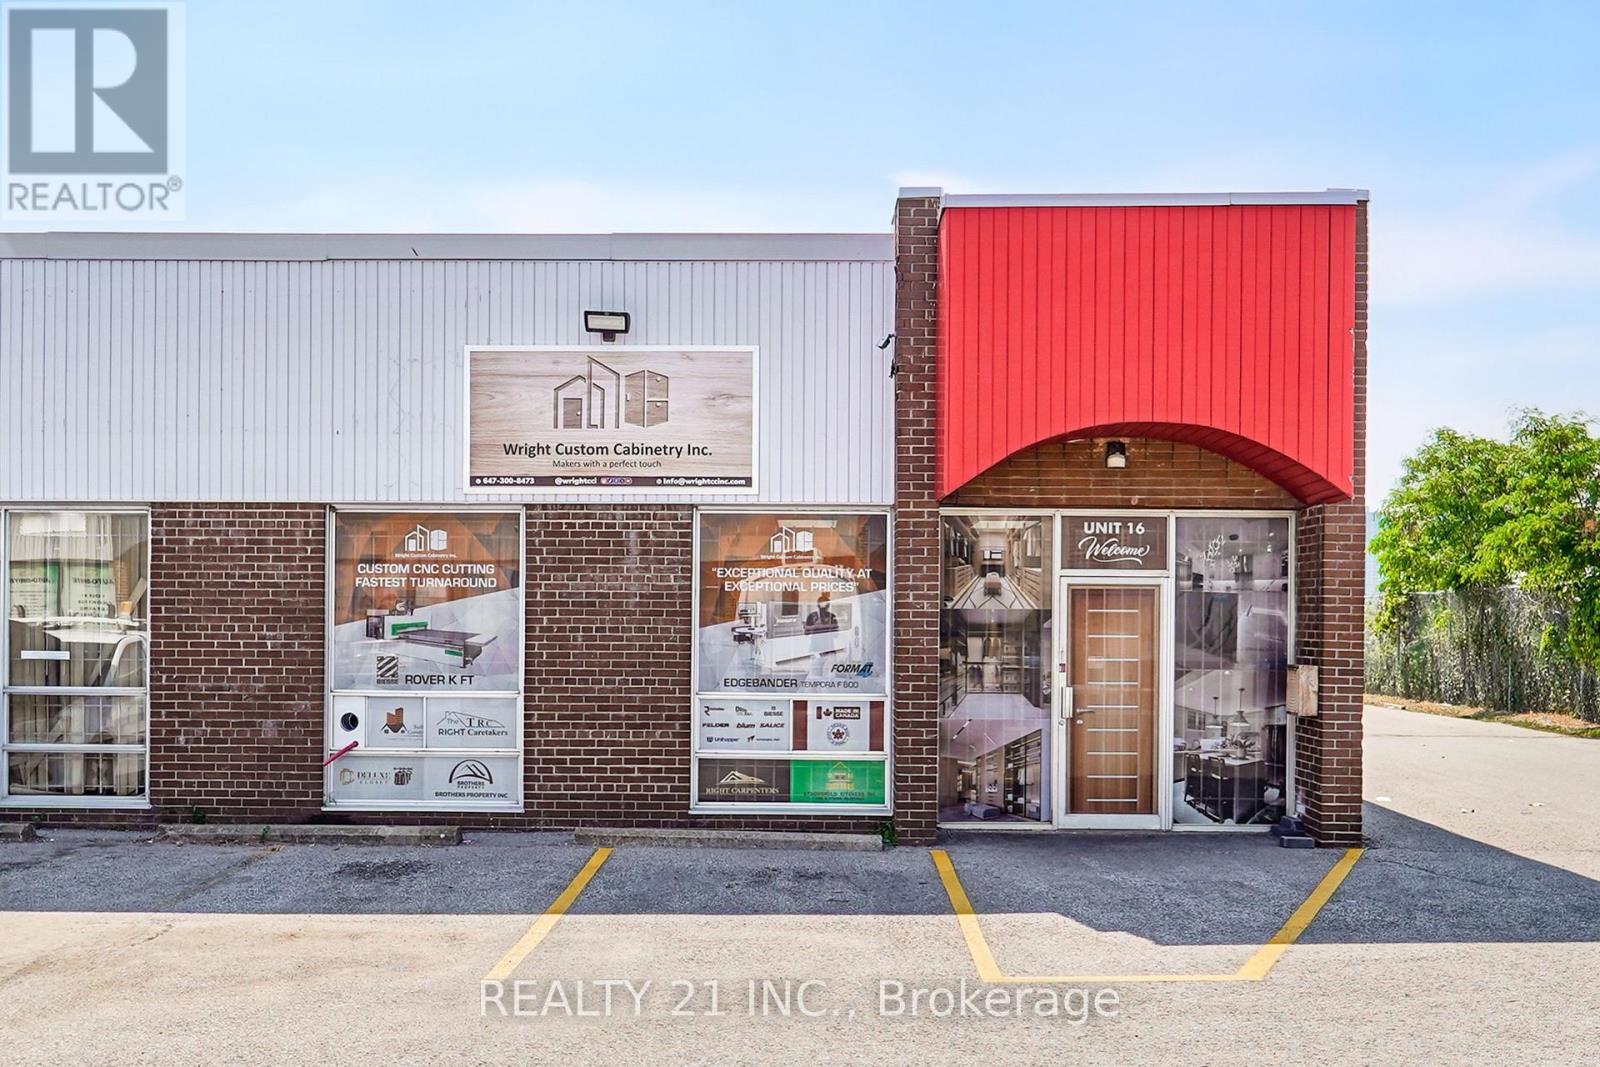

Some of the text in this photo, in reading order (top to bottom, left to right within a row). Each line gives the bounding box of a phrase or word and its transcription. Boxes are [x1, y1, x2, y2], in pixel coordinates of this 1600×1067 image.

[503, 442, 713, 459] Wright Custom Cabinetry Inc.
[552, 460, 581, 468] Makers
[583, 460, 601, 468] with
[609, 460, 637, 469] perfect
[639, 460, 662, 468] touch
[1083, 522, 1146, 535] UNIT 16
[1078, 536, 1150, 565] Welcome
[357, 563, 495, 574] CUSTOM CNC CUTTING
[802, 567, 853, 579] QUALITY
[854, 568, 872, 579] AT
[355, 577, 497, 588] FASTEST TURNAROUND
[724, 581, 807, 592] EXCEPTIONAL
[831, 662, 873, 675] FORMAT
[405, 674, 475, 685] ROVER K FT
[723, 678, 798, 688] EDGEBANDER
[843, 681, 859, 689] 600
[438, 728, 508, 736] RIGHT Caretakers
[705, 787, 779, 795] RIGHT CARPENTERS
